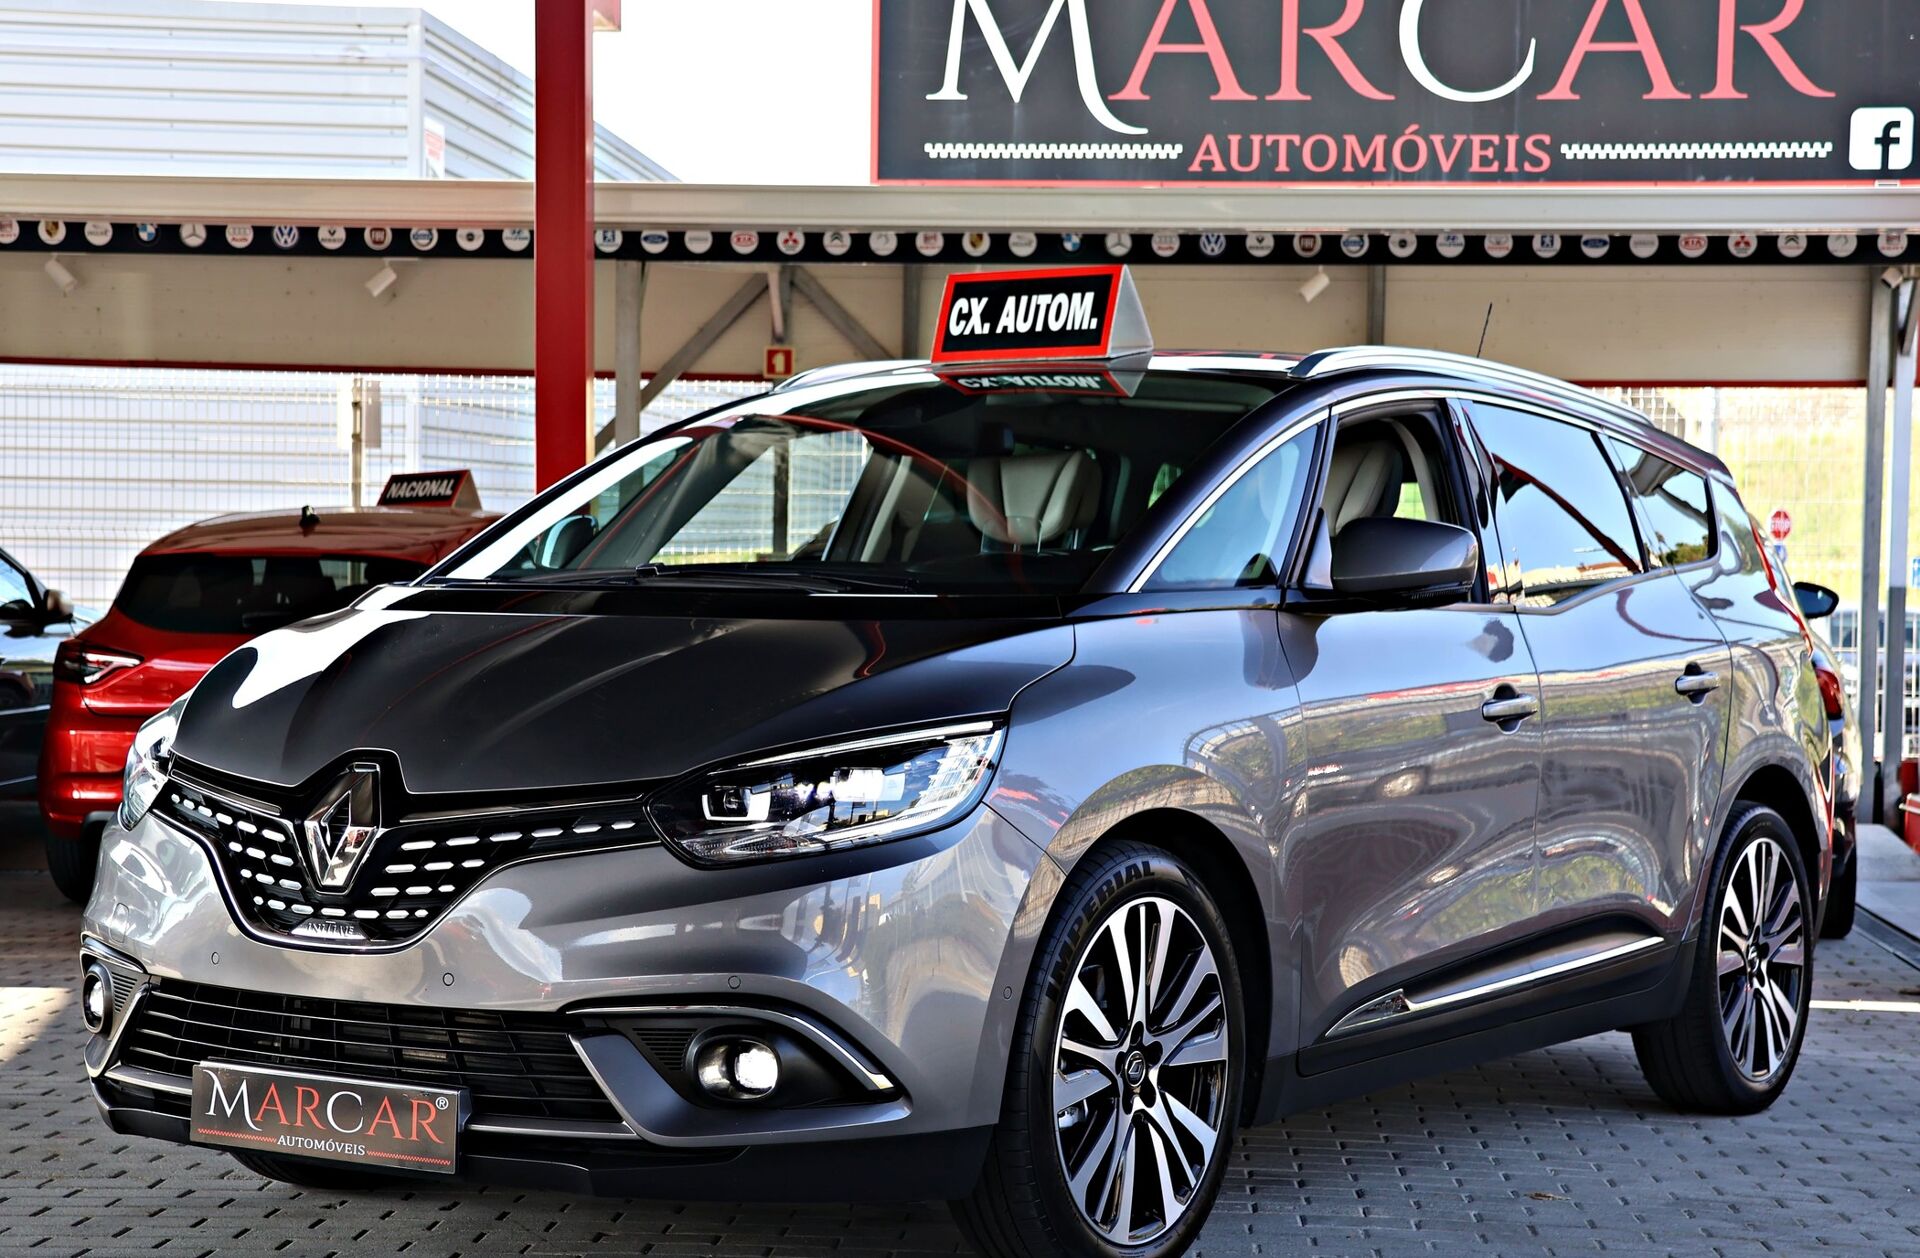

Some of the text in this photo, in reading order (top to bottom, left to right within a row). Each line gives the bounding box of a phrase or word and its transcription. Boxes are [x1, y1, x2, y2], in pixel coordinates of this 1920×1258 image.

[1187, 124, 1552, 174] AUTOMÓVEIS
[948, 291, 1098, 336] CX. AUTOM.
[386, 479, 455, 499] NACIONAL
[277, 1135, 366, 1156] AUTOMÓVEIS
